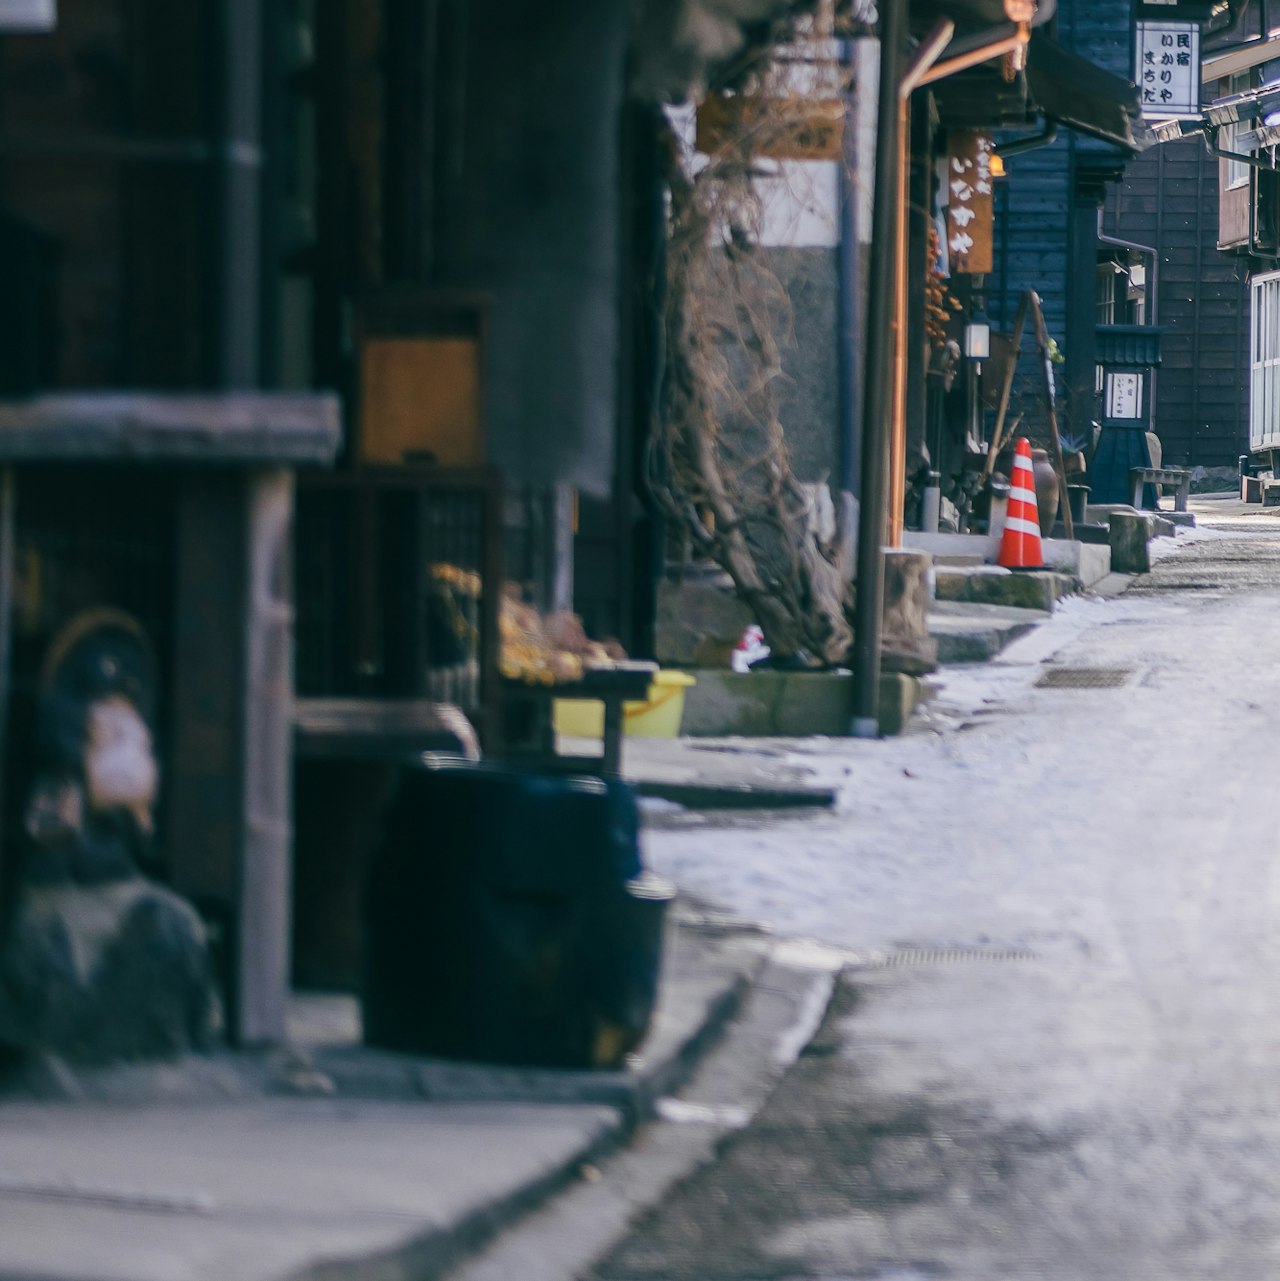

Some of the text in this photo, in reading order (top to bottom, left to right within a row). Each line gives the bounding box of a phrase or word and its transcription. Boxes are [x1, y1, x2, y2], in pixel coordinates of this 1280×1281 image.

[1143, 50, 1157, 102] まちだ
[1160, 34, 1173, 103] いかりや
[1177, 34, 1190, 66] 民宿
